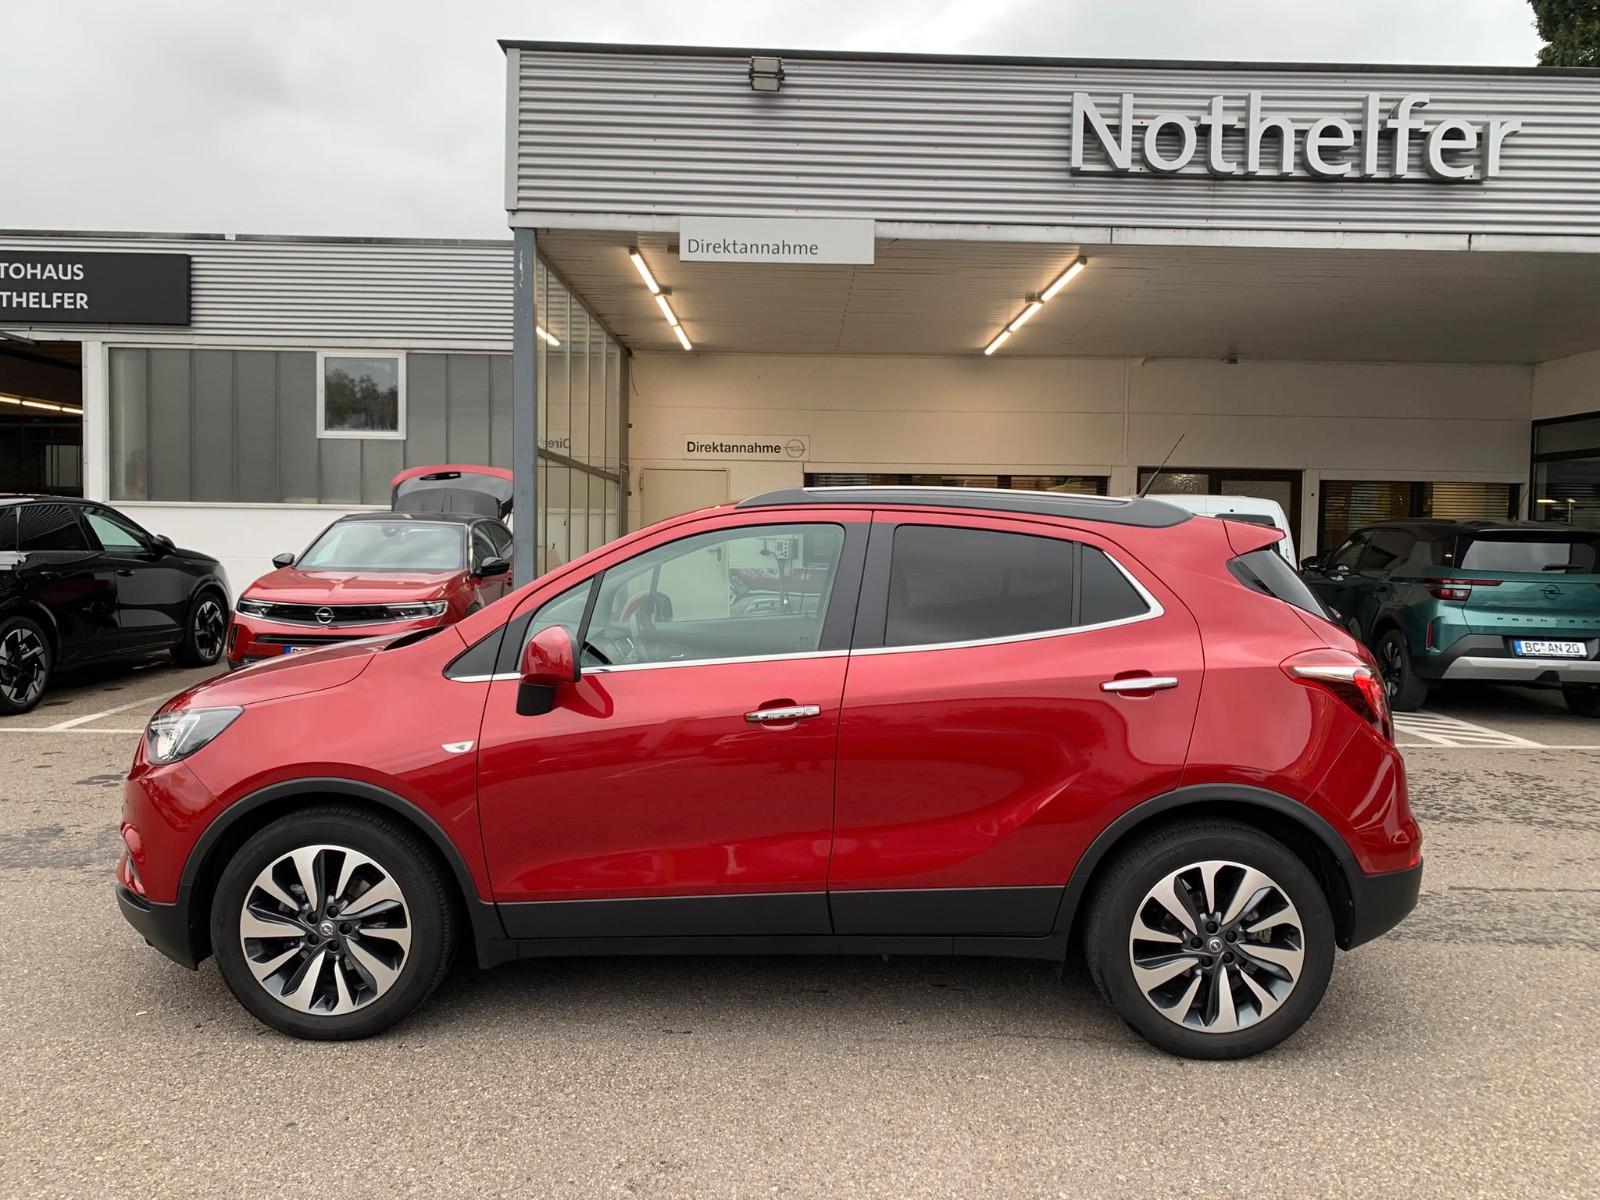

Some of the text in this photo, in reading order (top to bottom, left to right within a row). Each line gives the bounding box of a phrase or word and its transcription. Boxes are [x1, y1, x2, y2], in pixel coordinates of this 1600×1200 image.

[1071, 91, 1521, 179] Nothelfer
[687, 238, 819, 256] Direktannahme
[0, 291, 89, 310] THELFER
[686, 440, 782, 454] Direktannahme
[1524, 642, 1541, 653] BC
[1548, 643, 1562, 653] AN
